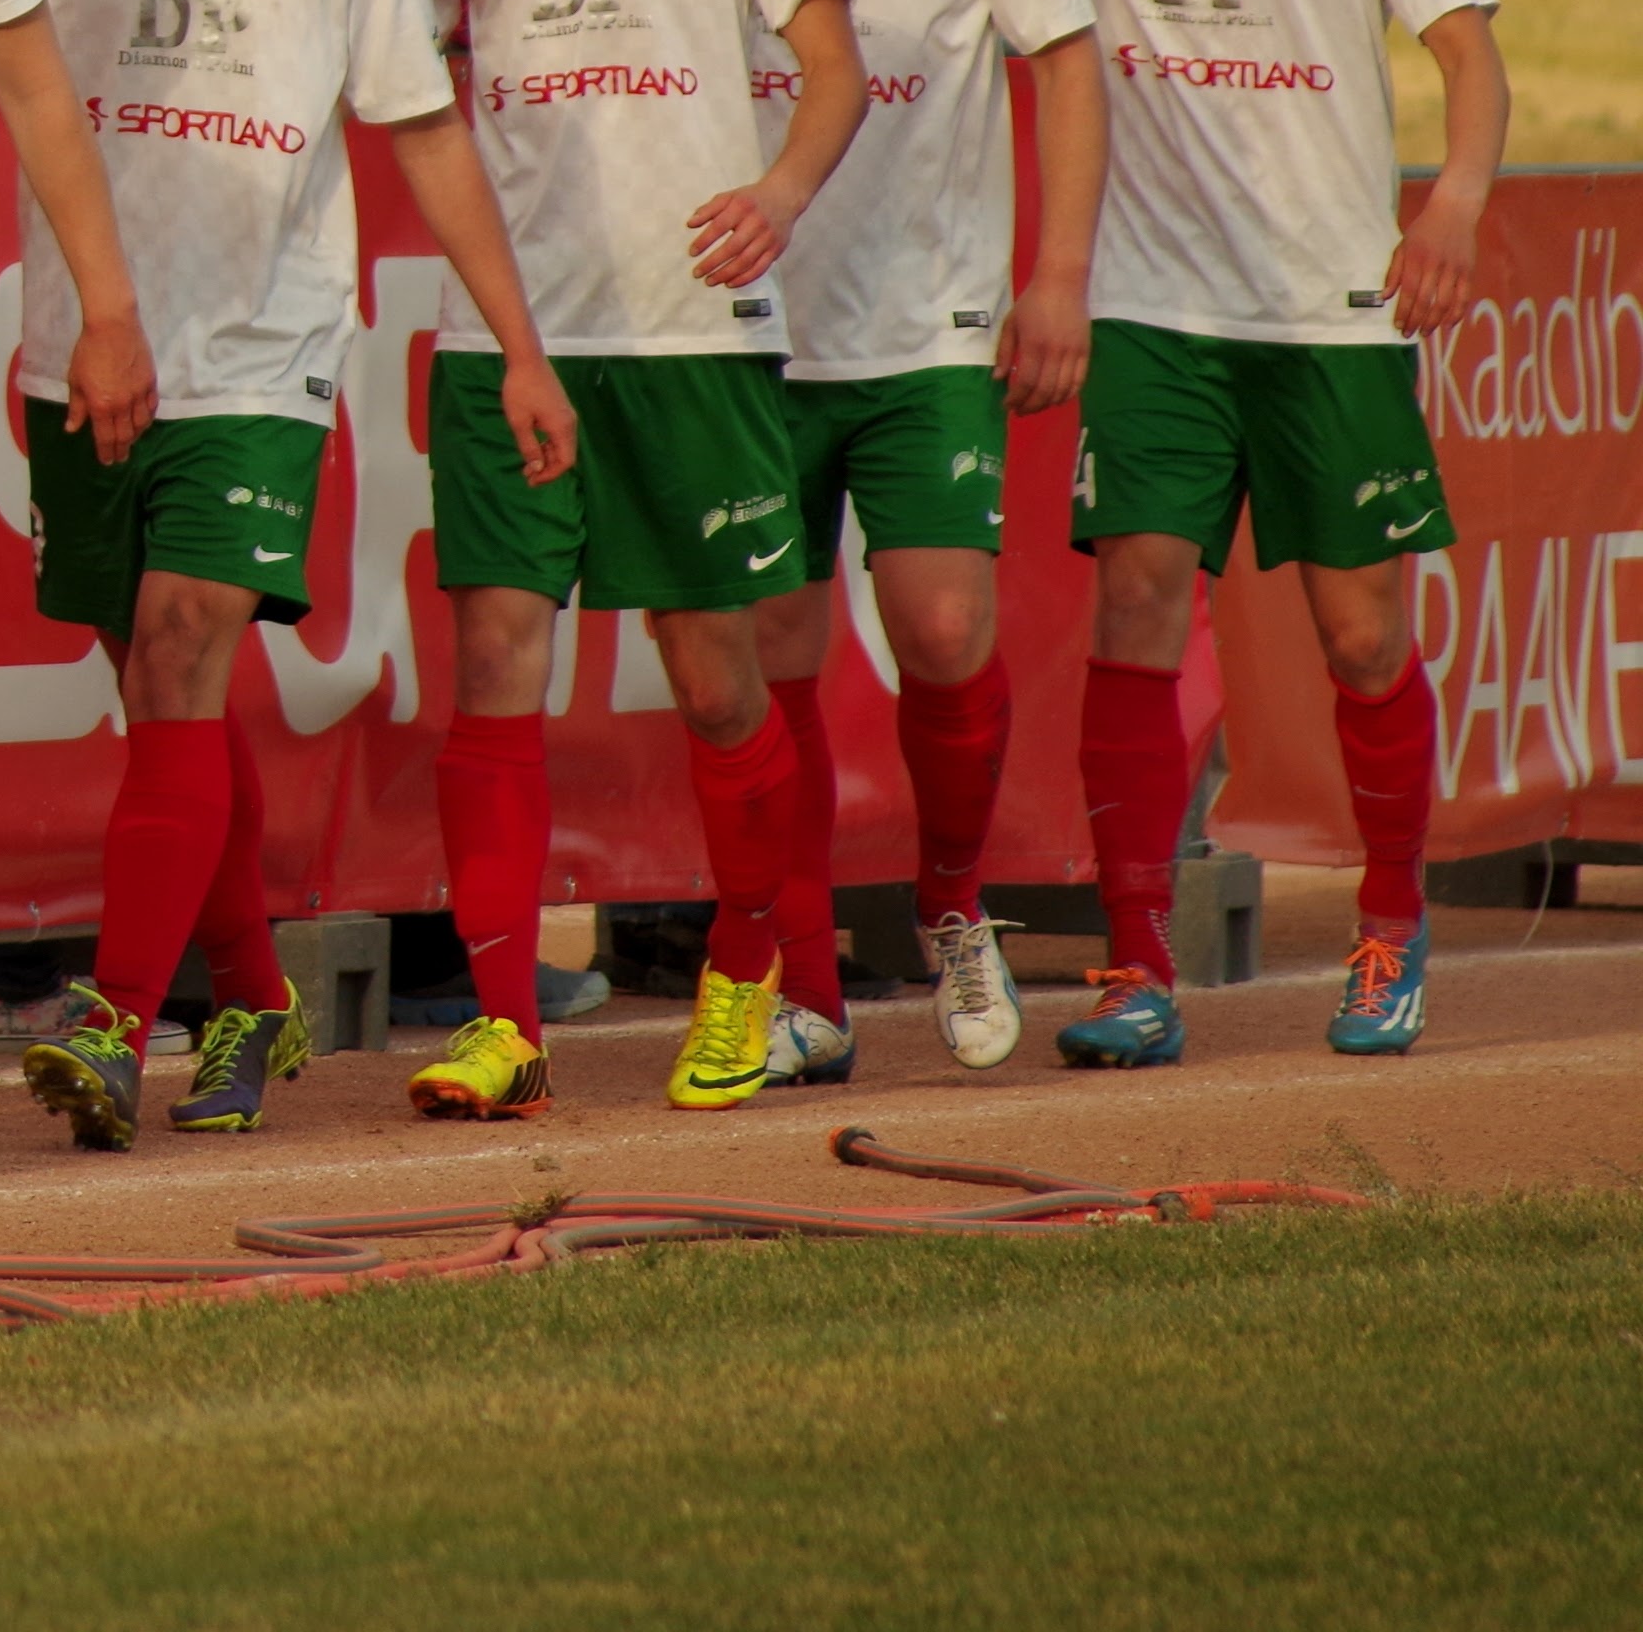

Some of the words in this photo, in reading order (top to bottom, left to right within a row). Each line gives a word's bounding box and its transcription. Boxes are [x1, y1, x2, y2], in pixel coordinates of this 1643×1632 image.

[118, 50, 199, 70] Diamon
[1153, 54, 1335, 91] SPORTLAND
[522, 65, 698, 104] SPORTLAND
[751, 70, 926, 104] SPOAND
[118, 103, 306, 154] SPORTLAND
[1416, 227, 1643, 439] kaadib
